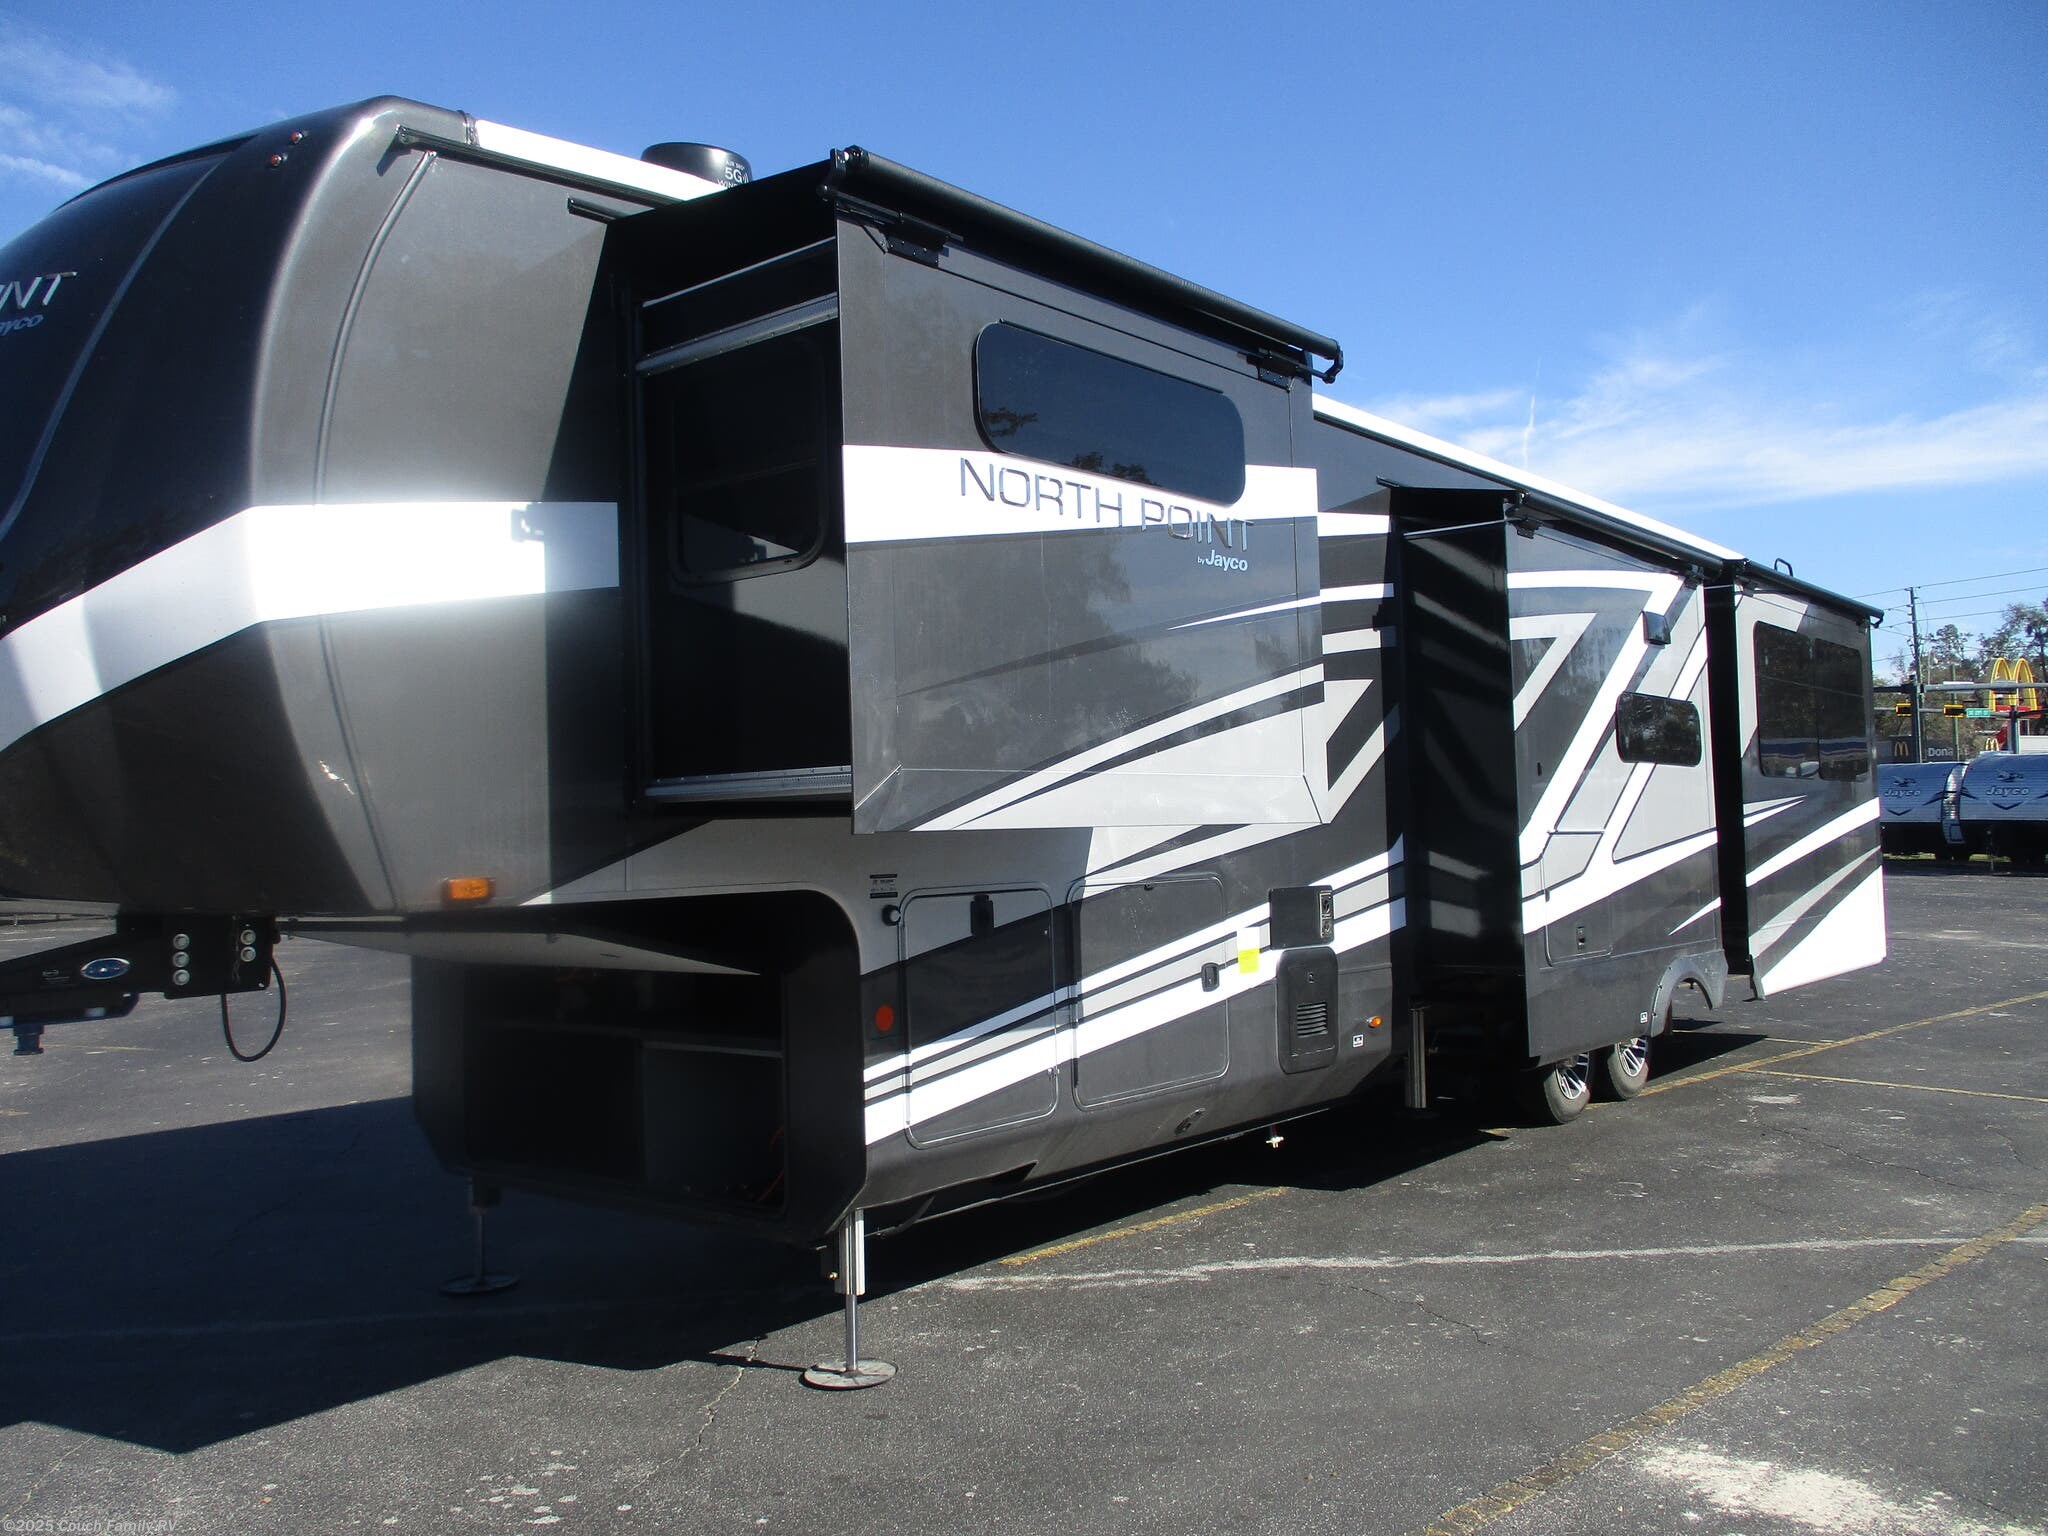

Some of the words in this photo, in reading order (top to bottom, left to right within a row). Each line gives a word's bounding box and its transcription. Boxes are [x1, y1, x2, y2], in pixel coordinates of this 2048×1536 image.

[724, 167, 744, 184] 5G
[960, 457, 1123, 527] NORTH
[1140, 498, 1256, 552] POINT
[1205, 549, 1249, 572] Jayco
[1884, 788, 1921, 798] Jayco
[1985, 785, 2030, 797] Jayco
